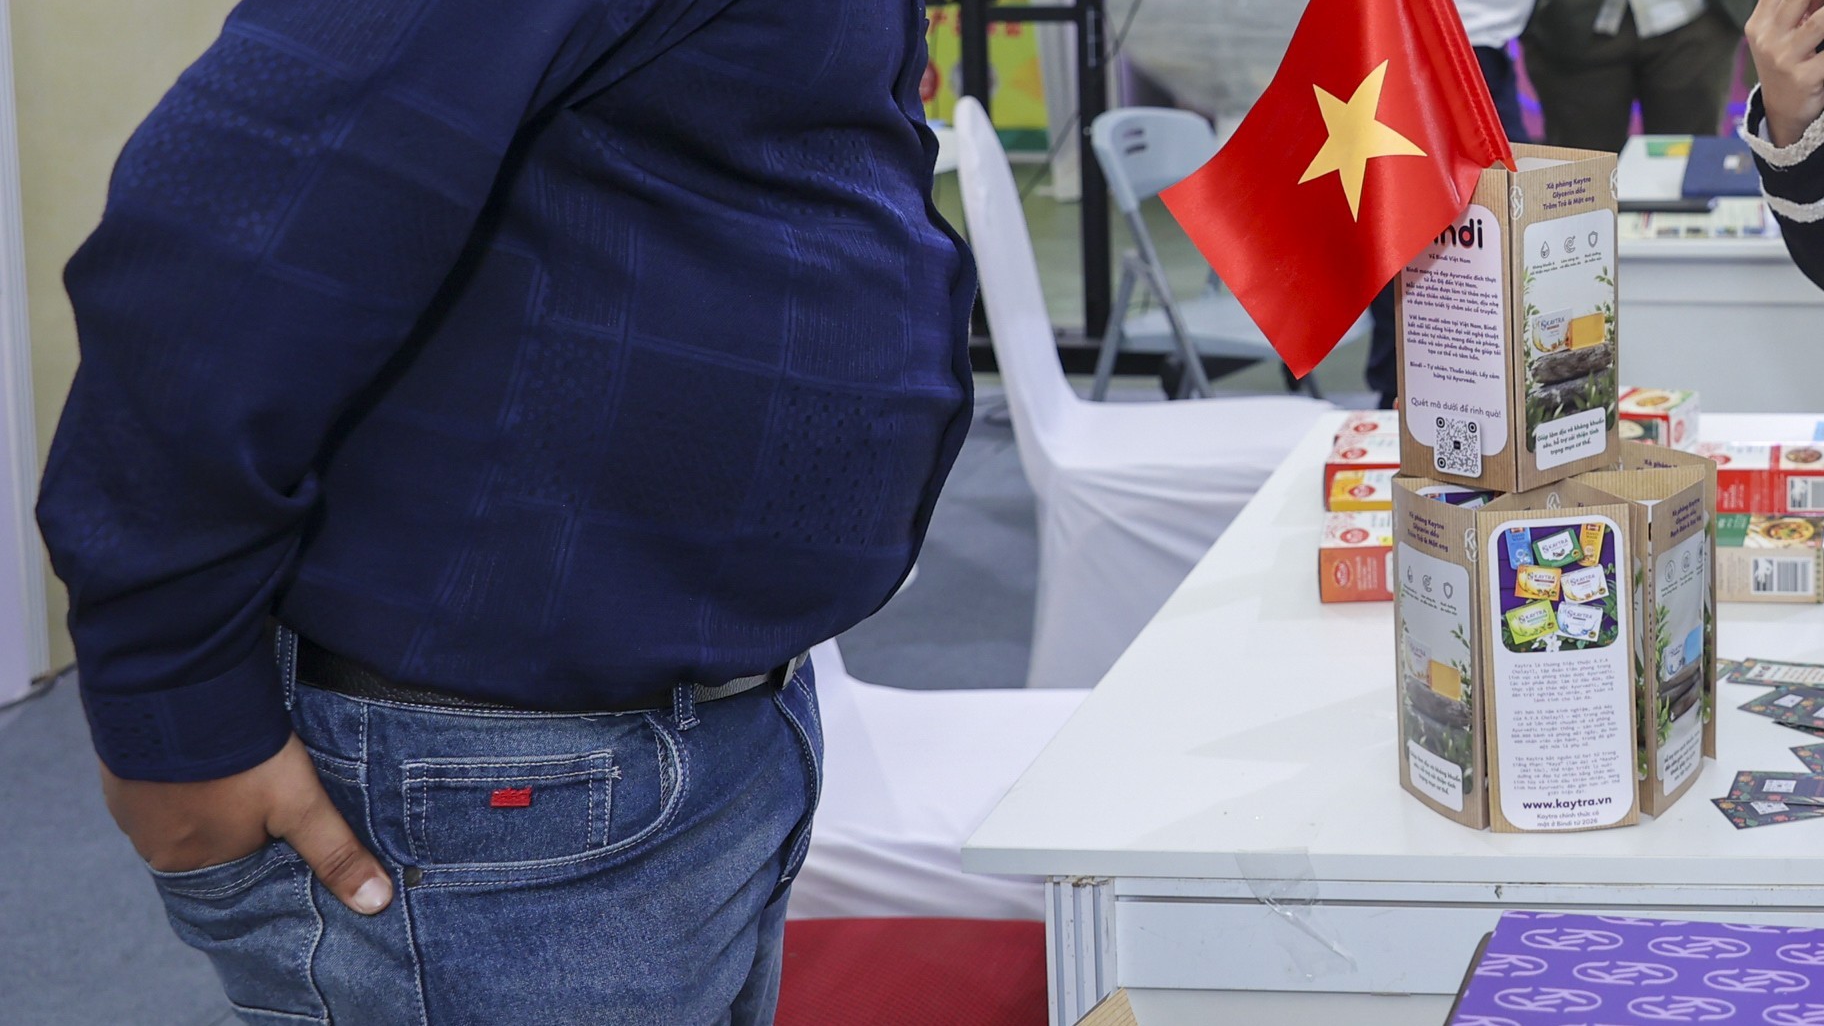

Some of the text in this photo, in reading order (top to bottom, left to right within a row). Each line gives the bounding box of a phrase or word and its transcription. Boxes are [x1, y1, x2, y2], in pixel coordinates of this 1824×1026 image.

[1574, 177, 1591, 185] Kaytra
[1434, 218, 1482, 249] ndi
[1547, 317, 1565, 325] KAYTRA
[1411, 397, 1428, 407] Quét
[1443, 403, 1458, 411] dưới
[1470, 406, 1484, 415] rinh
[1549, 538, 1568, 549] KAYTRA
[1523, 797, 1612, 810] www.kaytra.vn
